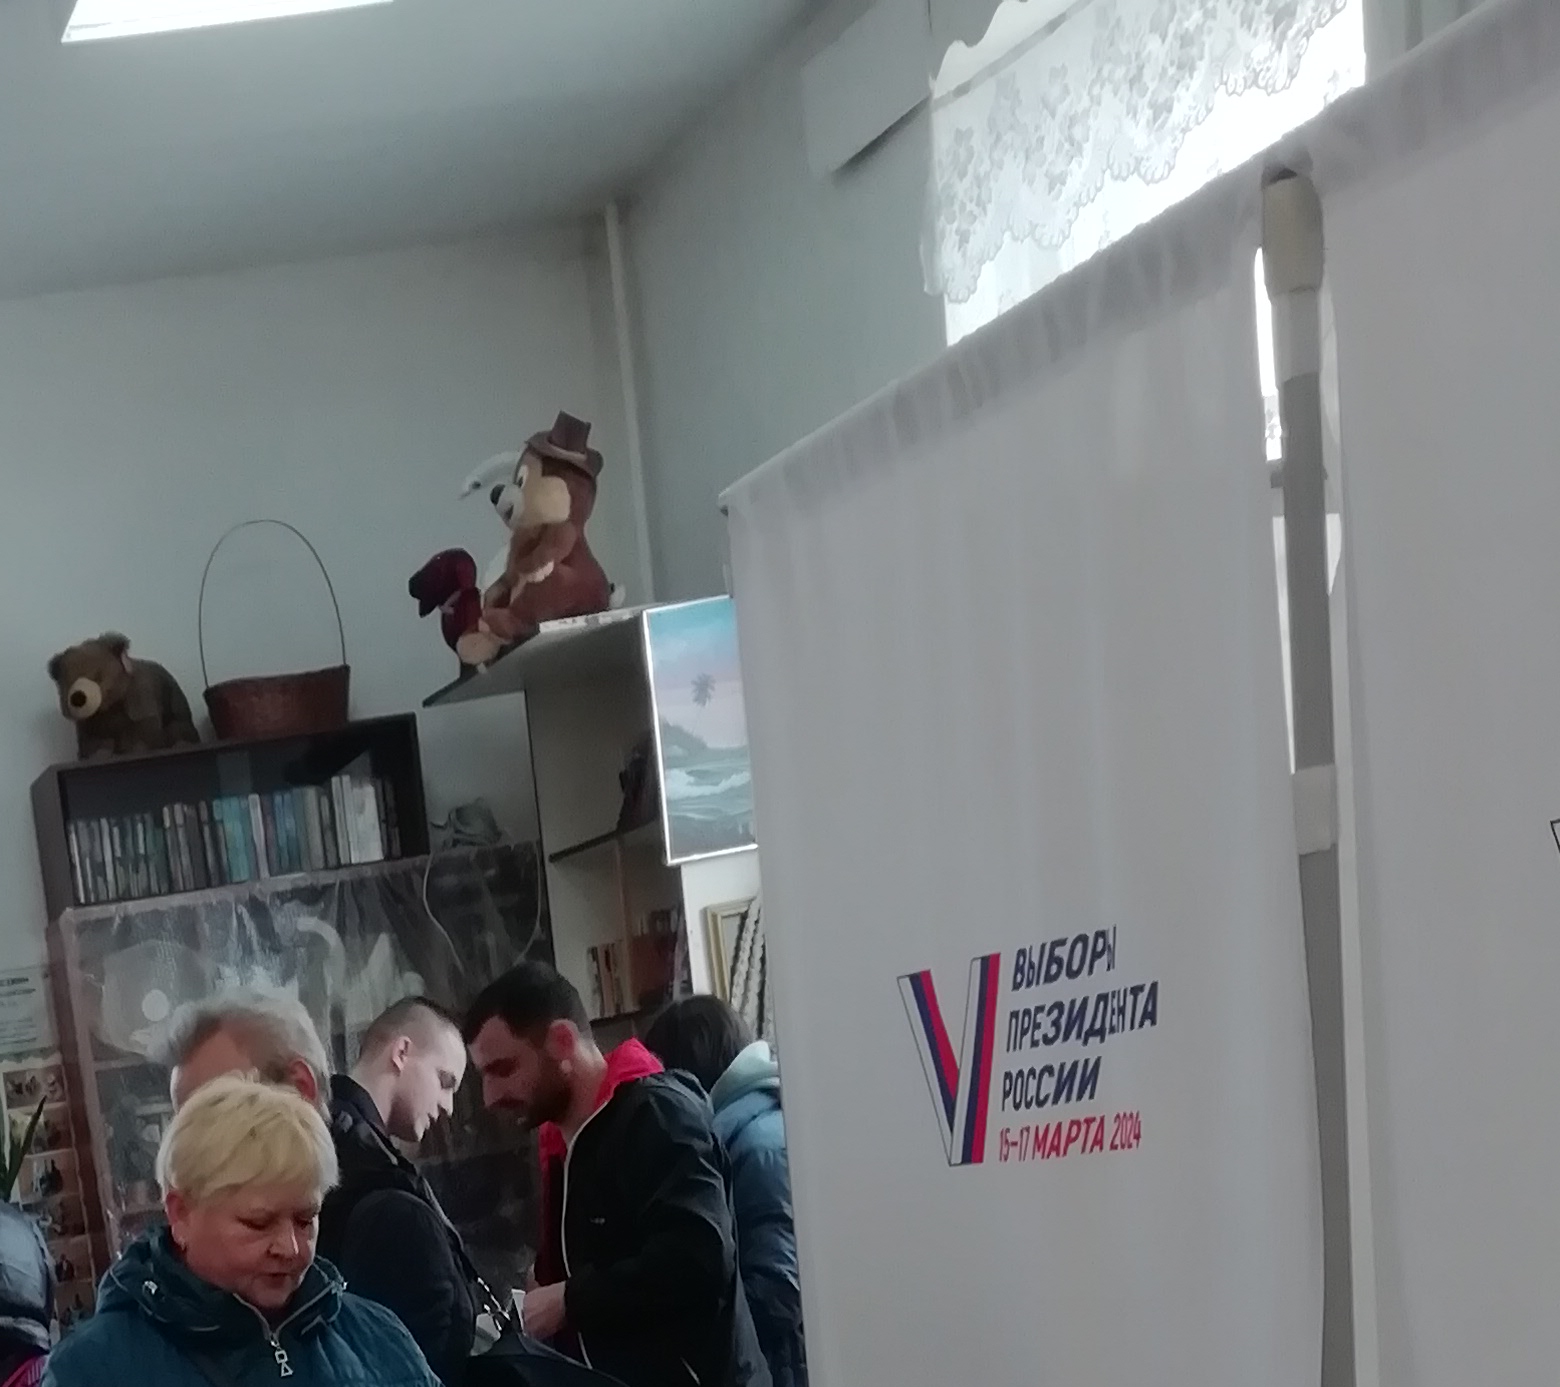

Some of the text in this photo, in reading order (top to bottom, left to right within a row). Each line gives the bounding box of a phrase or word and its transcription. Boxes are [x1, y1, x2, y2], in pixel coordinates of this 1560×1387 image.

[1006, 980, 1159, 1053] ПРЕЗИДЕНТА
[1002, 1056, 1102, 1111] РОССИИ
[1031, 1115, 1105, 1159] МАРТА
[1109, 1110, 1142, 1151] 2024
